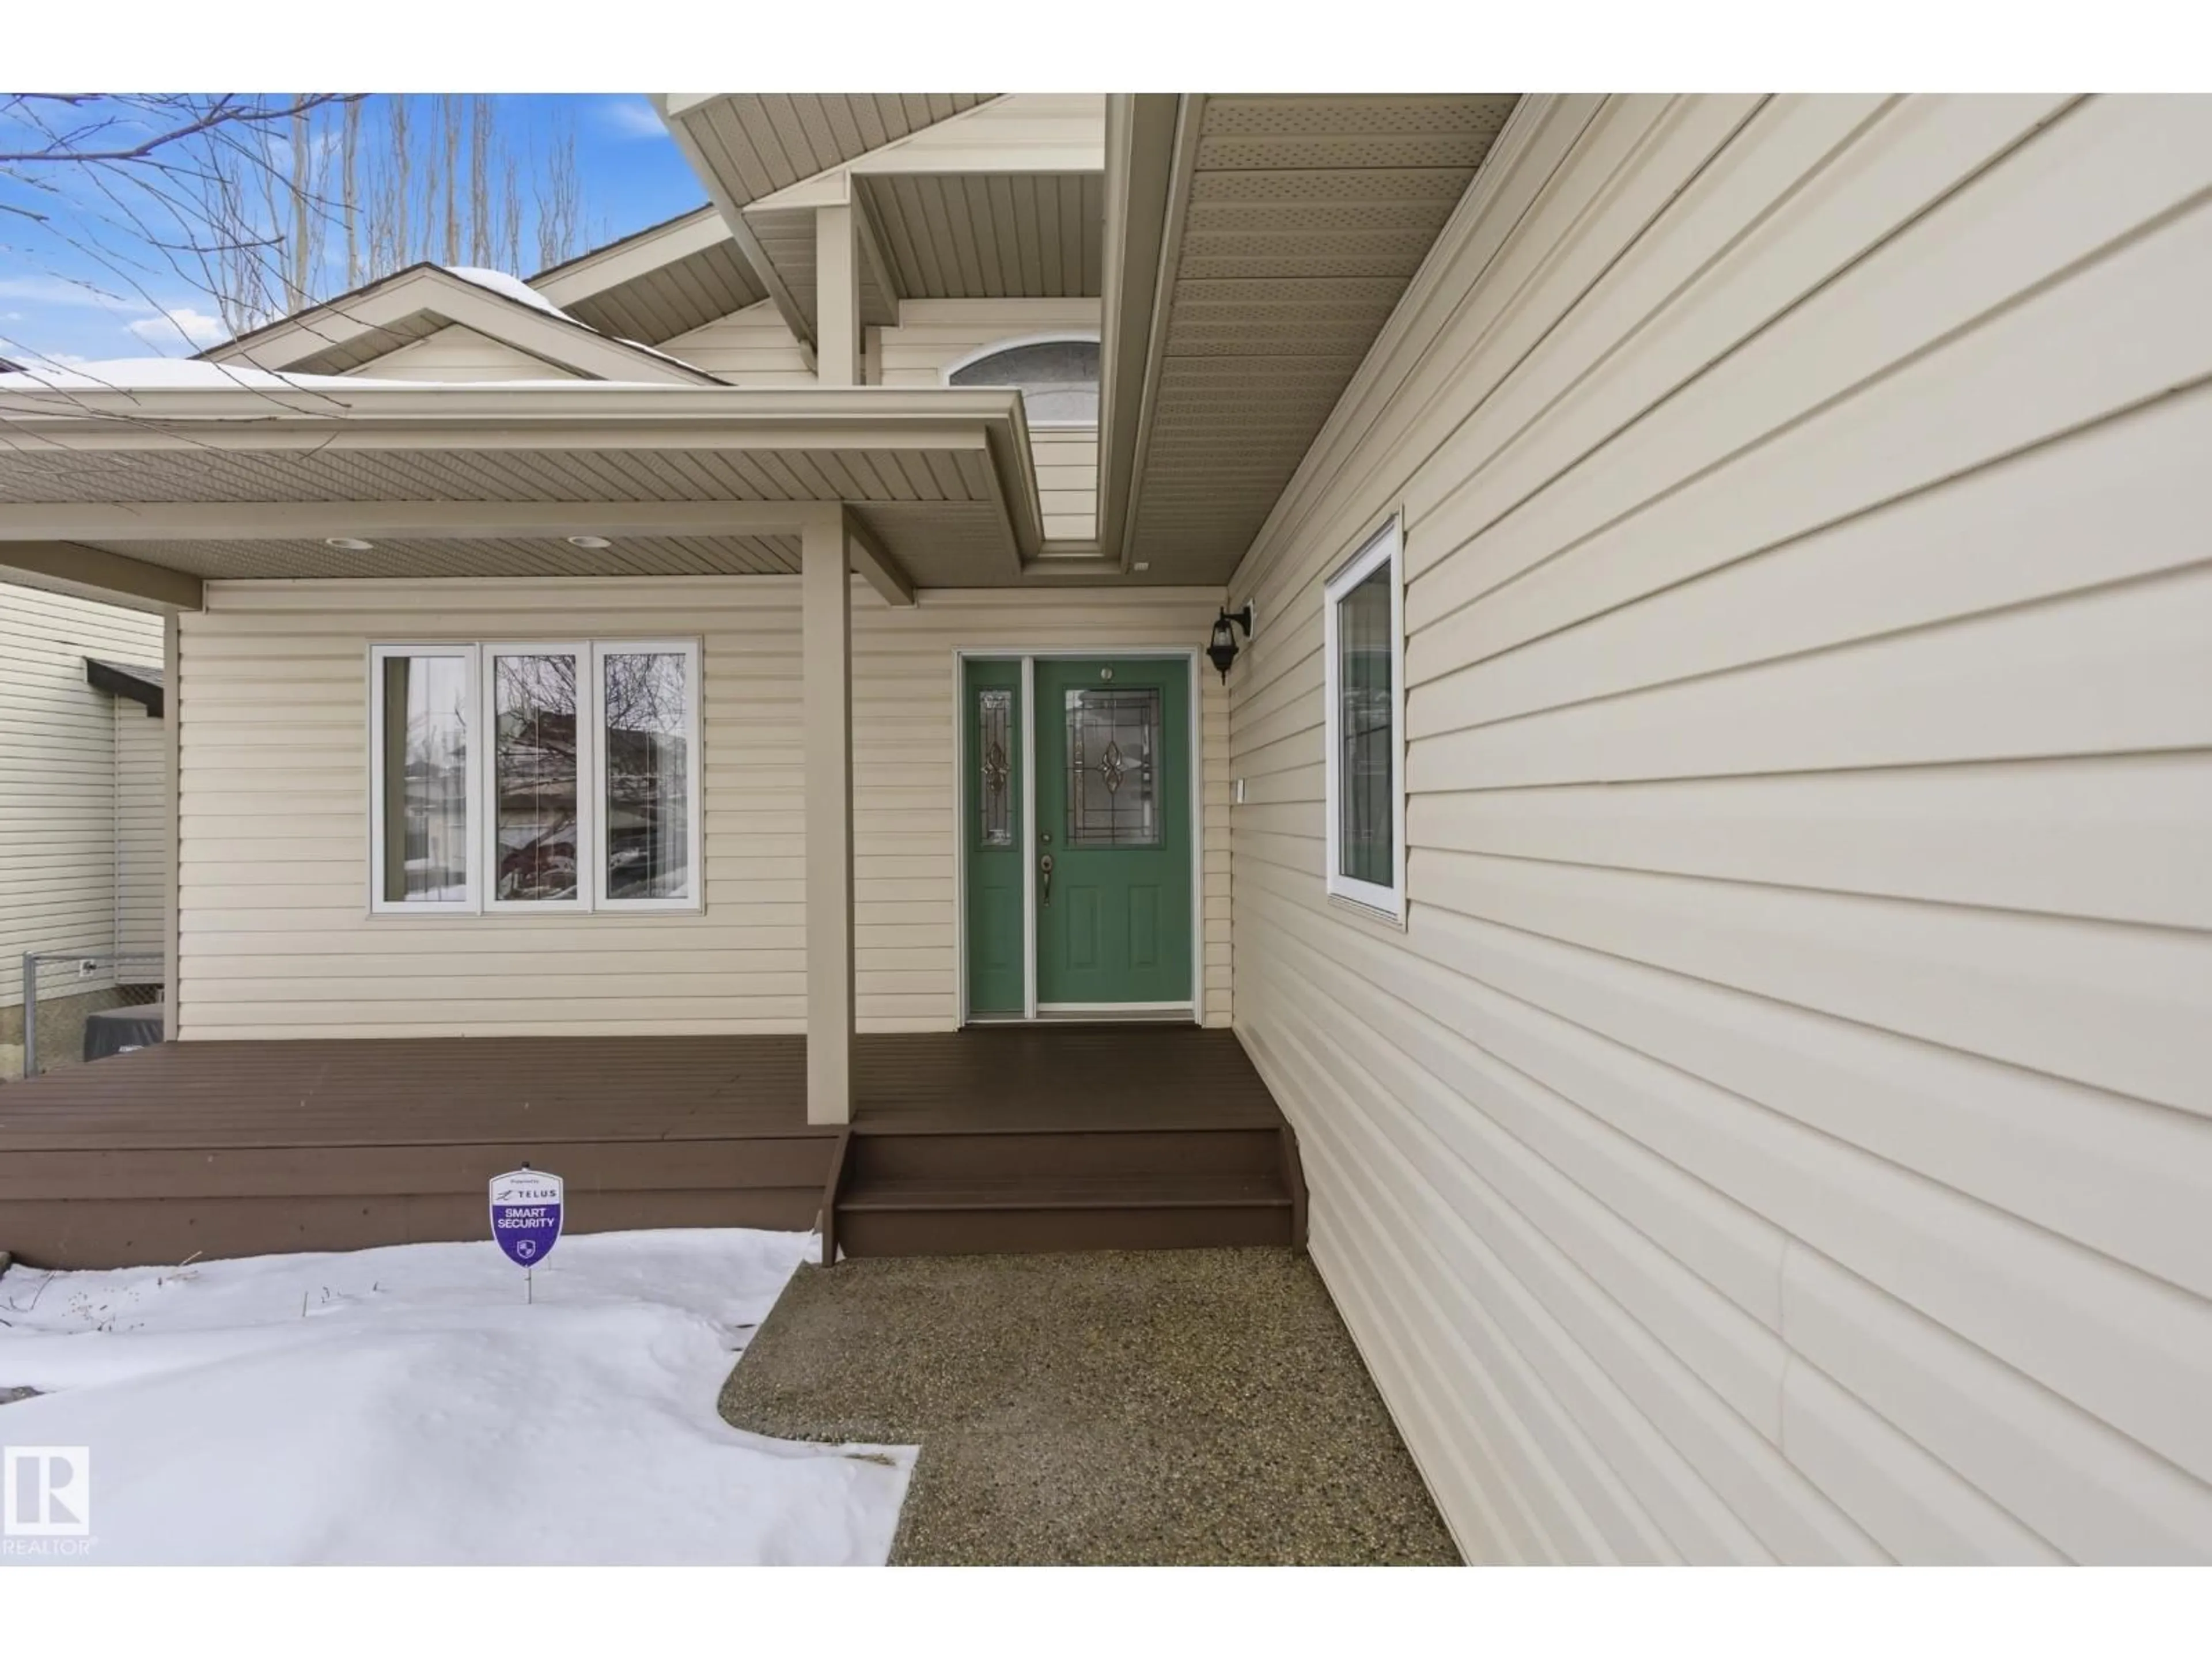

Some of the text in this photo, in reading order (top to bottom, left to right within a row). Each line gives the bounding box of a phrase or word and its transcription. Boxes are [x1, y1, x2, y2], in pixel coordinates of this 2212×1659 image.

[518, 1190, 556, 1198] TELUS
[505, 1208, 547, 1218] SMART
[497, 1218, 555, 1229] SECURITY
